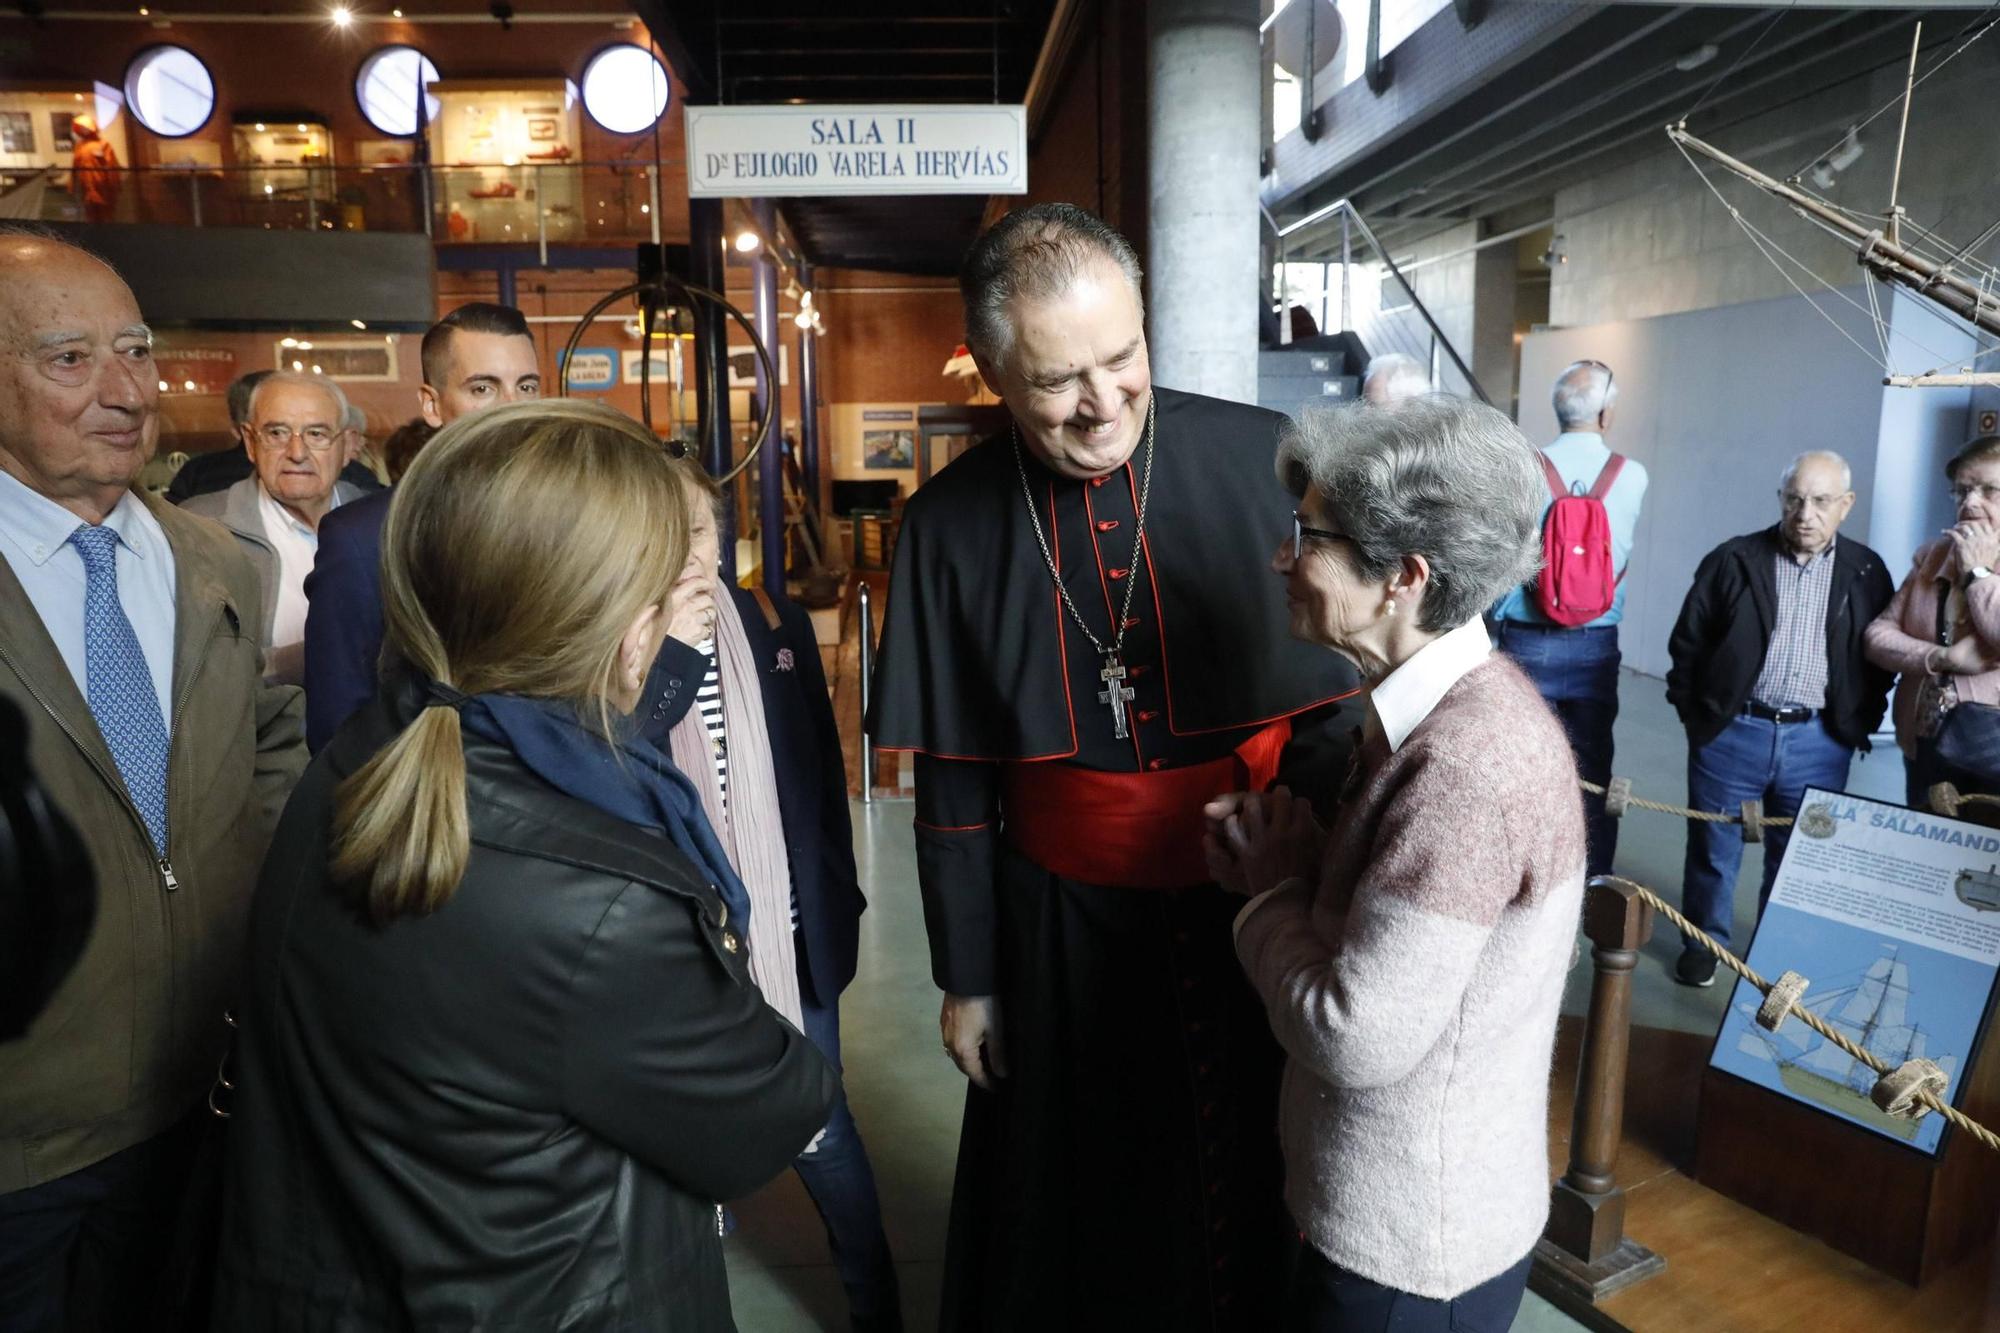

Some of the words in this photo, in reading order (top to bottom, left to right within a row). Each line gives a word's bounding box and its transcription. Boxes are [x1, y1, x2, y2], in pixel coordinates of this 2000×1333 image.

[811, 118, 882, 145] SALA
[897, 118, 916, 144] II
[734, 151, 818, 178] EULOGIO
[829, 151, 906, 179] VARELA
[915, 146, 1009, 180] HERVÍAS
[1831, 803, 1857, 823] LA
[1870, 812, 2000, 855] SALAMAND
